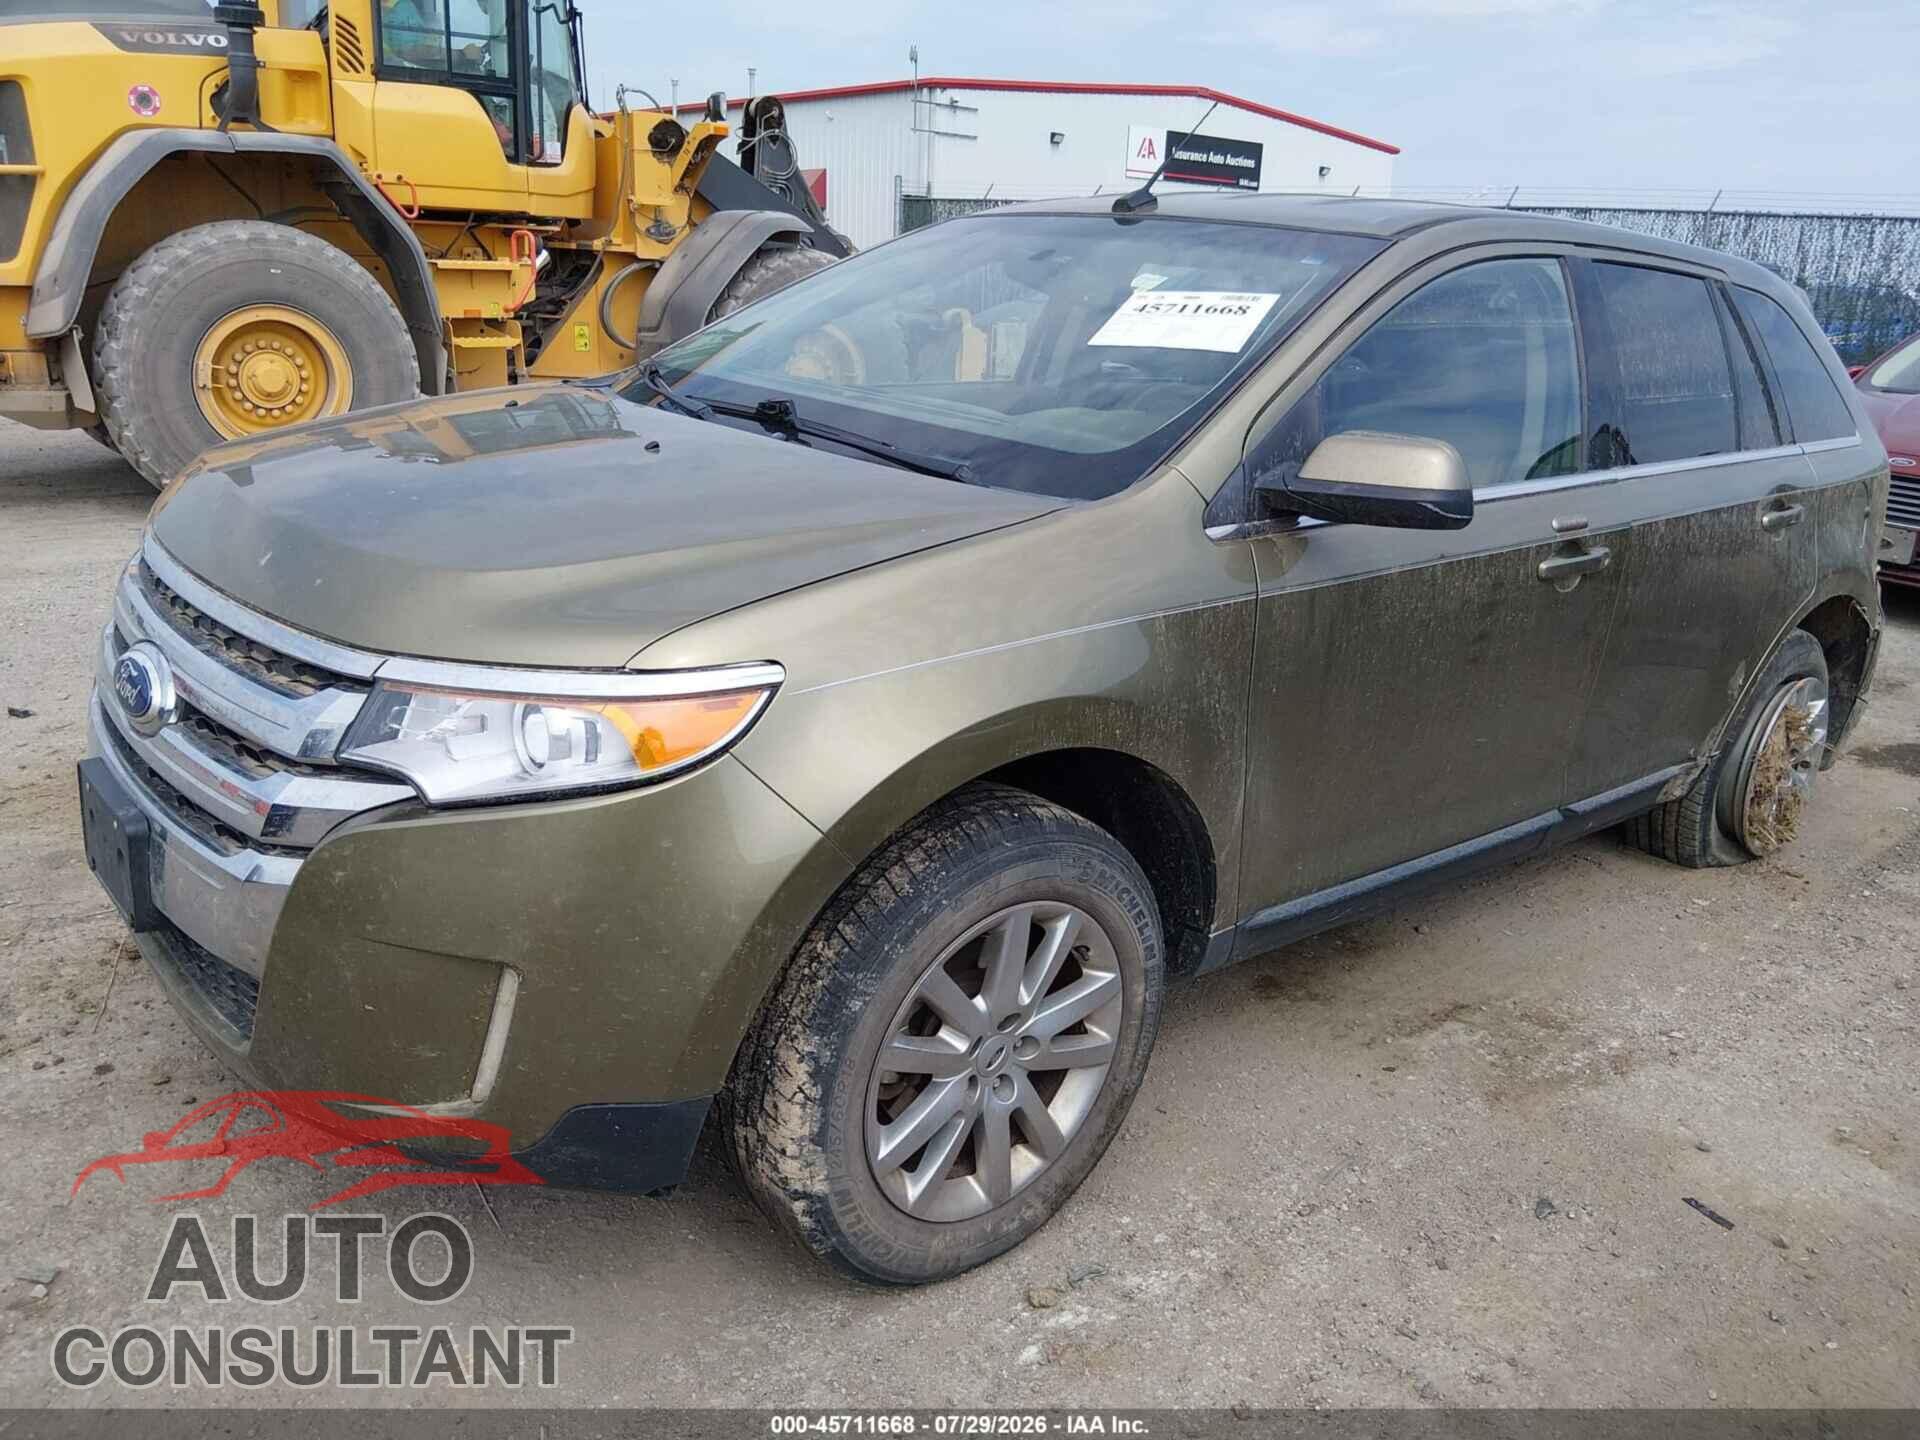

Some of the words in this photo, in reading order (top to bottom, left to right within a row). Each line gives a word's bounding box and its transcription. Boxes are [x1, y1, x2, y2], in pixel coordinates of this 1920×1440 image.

[120, 31, 228, 48] VOLVO
[1208, 151, 1225, 165] Auto
[1225, 154, 1256, 169] Auctions
[1133, 303, 1251, 316] 45711668
[115, 660, 141, 707] Ford
[1096, 861, 1160, 963] MICHELIN
